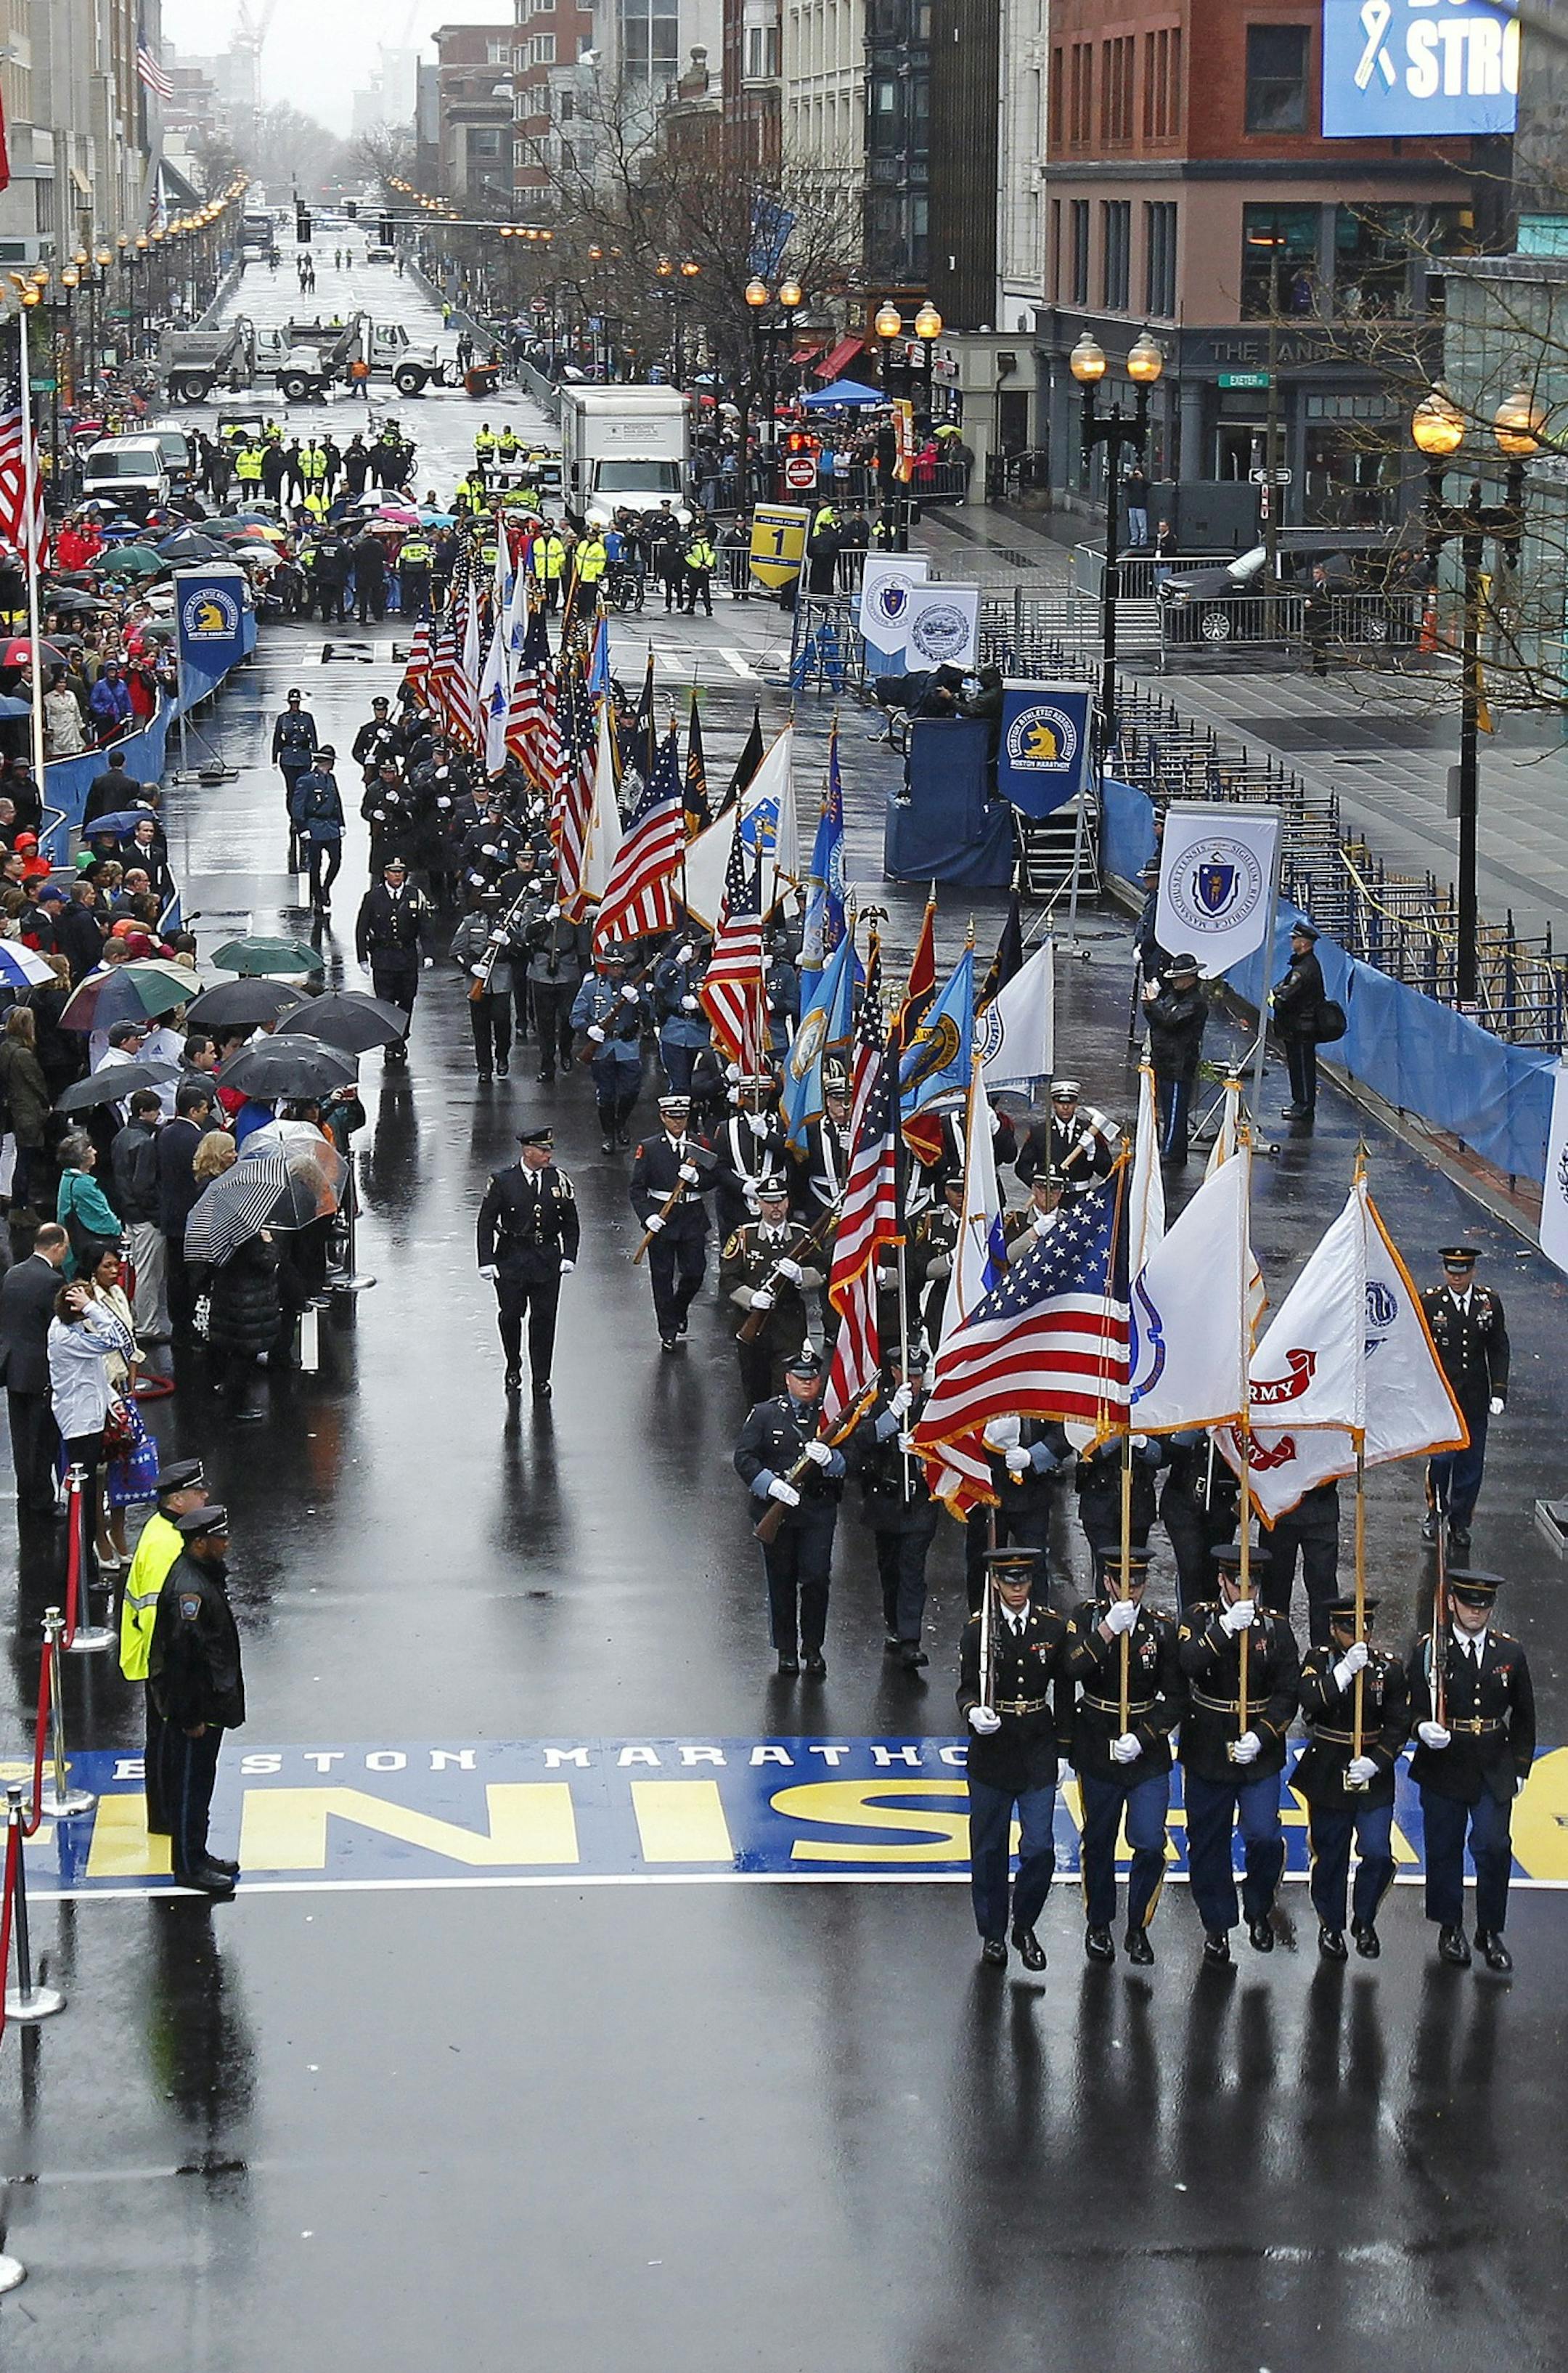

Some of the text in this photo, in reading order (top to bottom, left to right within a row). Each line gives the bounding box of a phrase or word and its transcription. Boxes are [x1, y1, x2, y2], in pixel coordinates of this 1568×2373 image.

[1210, 342, 1259, 361] THE
[1230, 375, 1257, 386] EXETER
[772, 528, 785, 555] 1
[1010, 709, 1074, 757] BOSTON ATHLETIC ASSOCIATION
[1249, 1380, 1294, 1401] RMY
[112, 1745, 969, 1781] BSTON MARATHO
